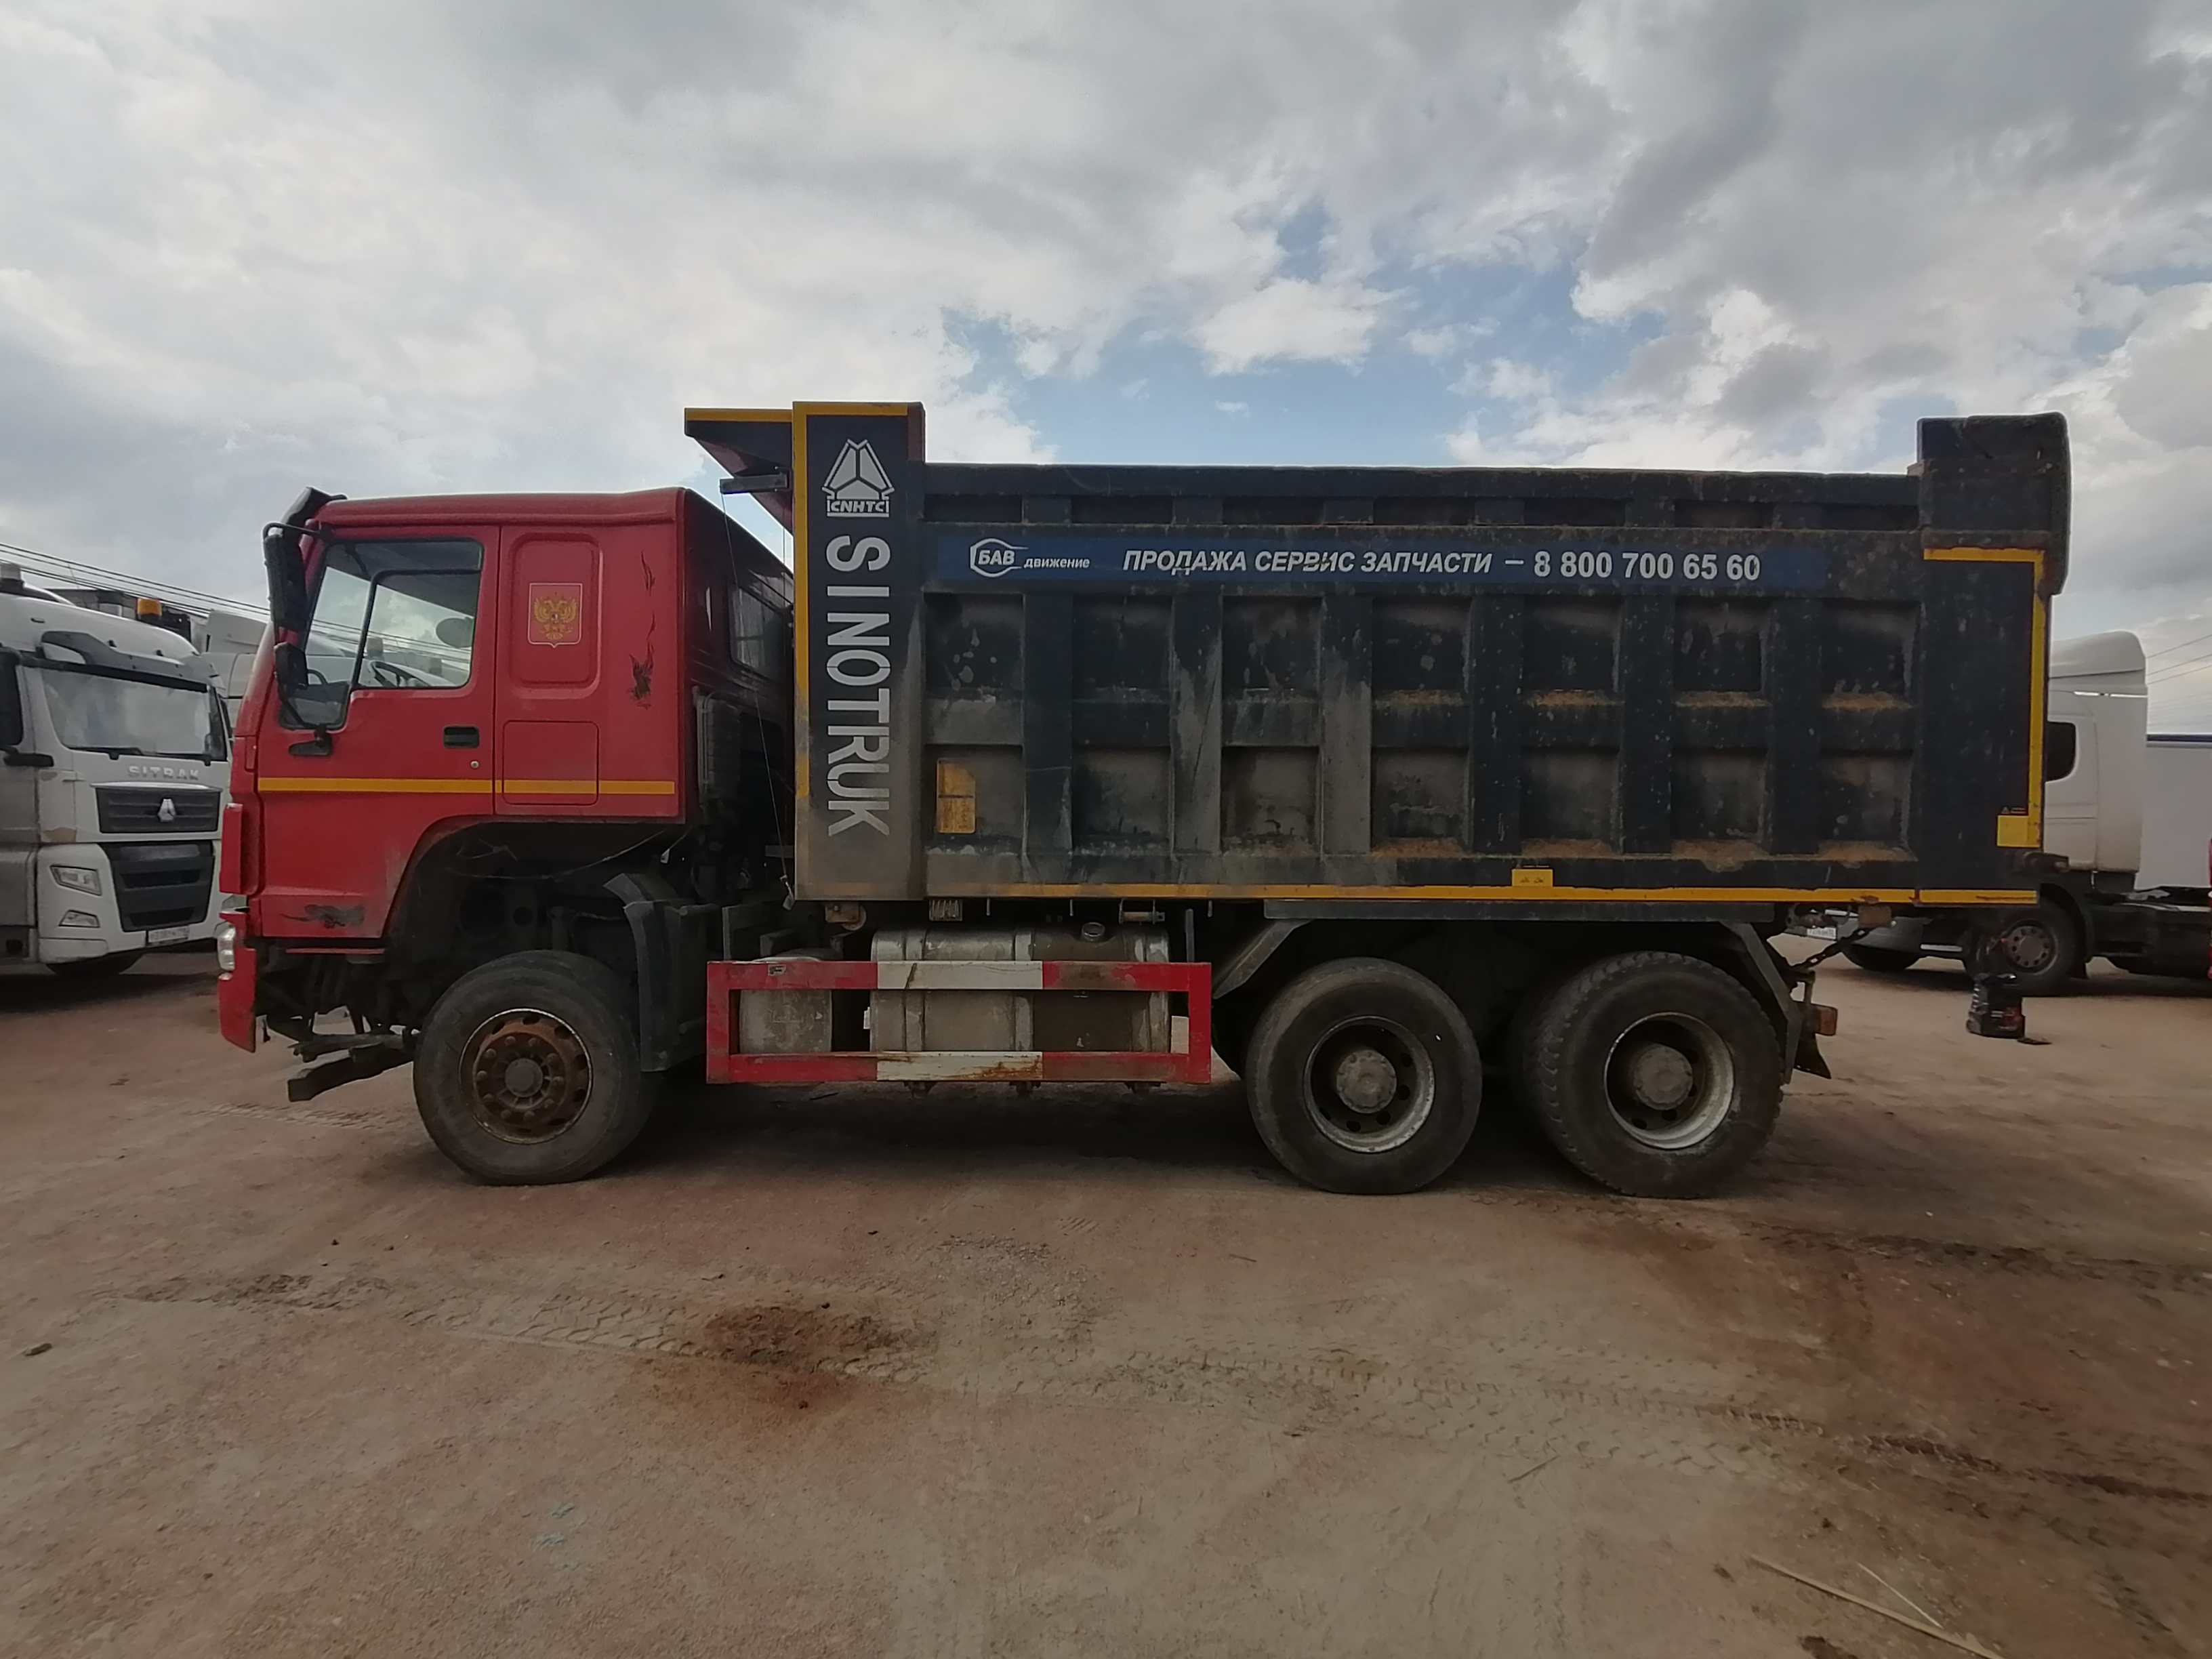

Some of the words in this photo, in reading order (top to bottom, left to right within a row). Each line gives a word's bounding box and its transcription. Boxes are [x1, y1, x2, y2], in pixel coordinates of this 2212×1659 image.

[831, 500, 885, 512] CNHTC
[978, 550, 1015, 565] БАВ
[1023, 558, 1090, 569] движение
[1123, 550, 1247, 575] ПРОДАЖА
[1255, 551, 1355, 572] СЕРВИС
[1360, 552, 1492, 573] ЗАПЧАСТИ
[1534, 551, 1551, 577] 8
[1560, 552, 1613, 578] 800
[1622, 552, 1674, 579] 700
[1683, 554, 1717, 579] 65
[1726, 554, 1760, 580] 60
[826, 535, 891, 836] SINOTRUK
[127, 765, 199, 780] SITRAK
